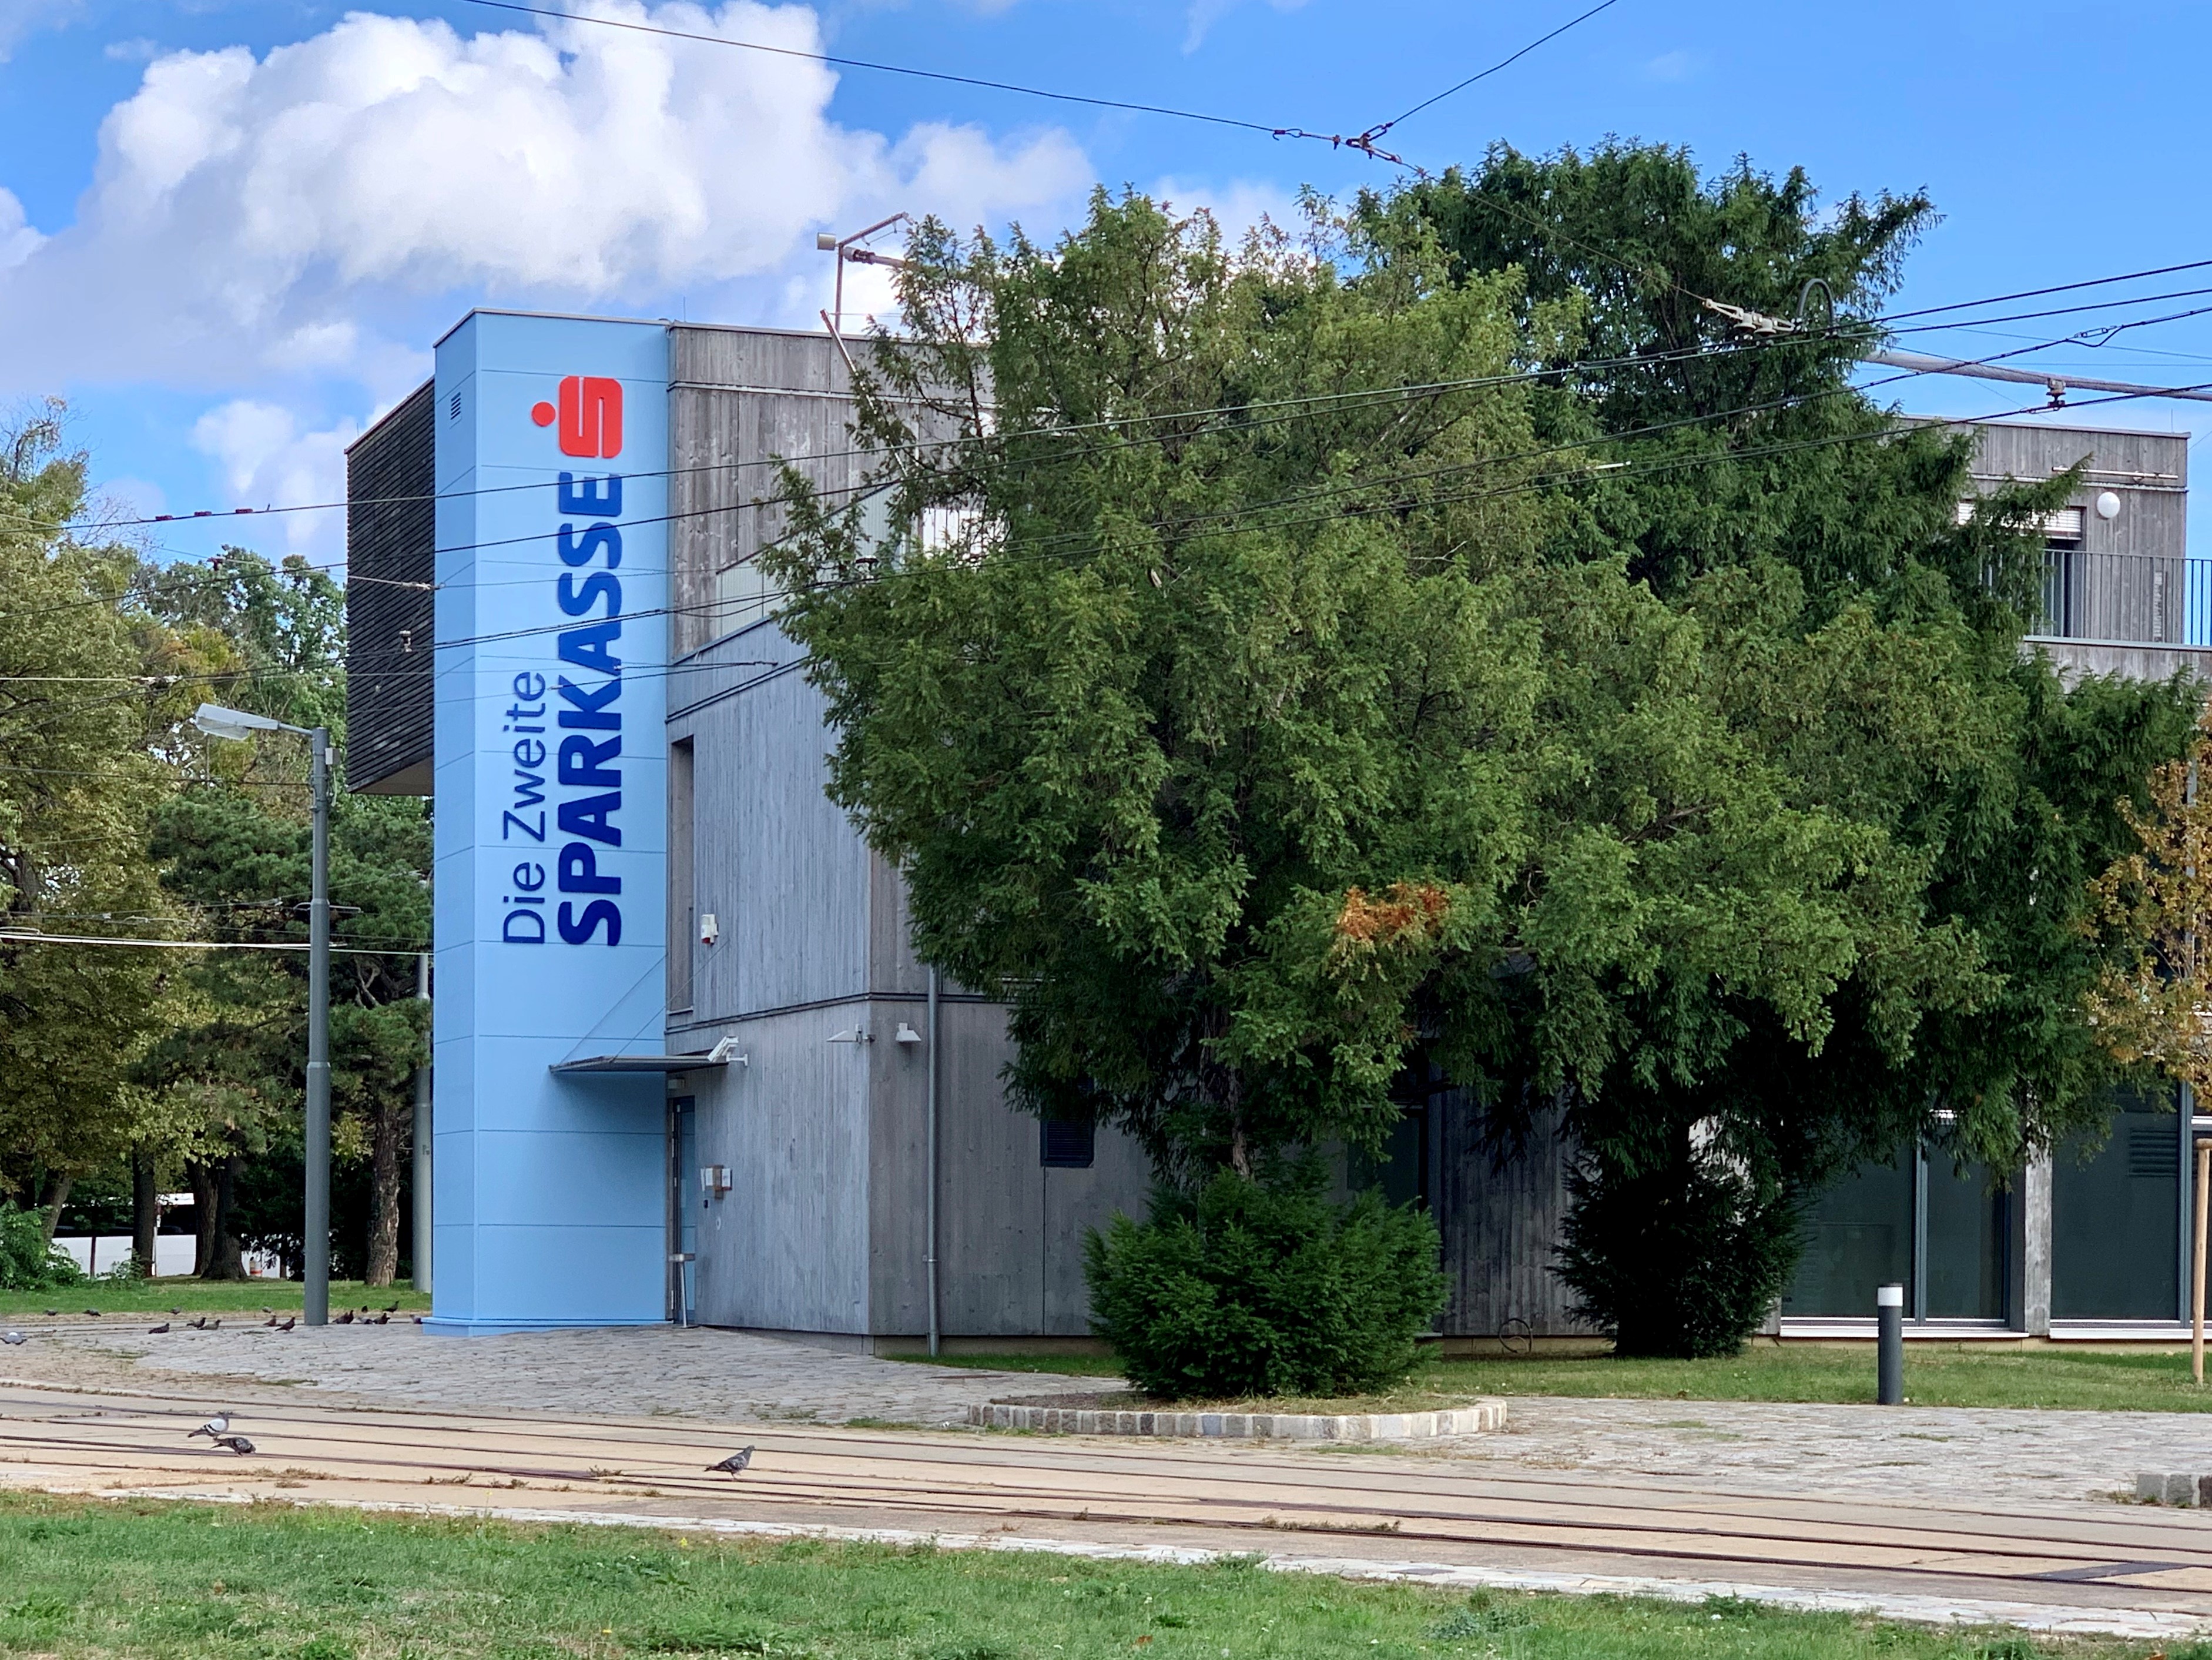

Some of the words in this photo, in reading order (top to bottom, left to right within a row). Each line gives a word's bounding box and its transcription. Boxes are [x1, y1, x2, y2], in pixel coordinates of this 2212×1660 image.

[502, 671, 546, 843] Zweite
[558, 471, 622, 947] SPARKASSE
[502, 861, 546, 945] Die
